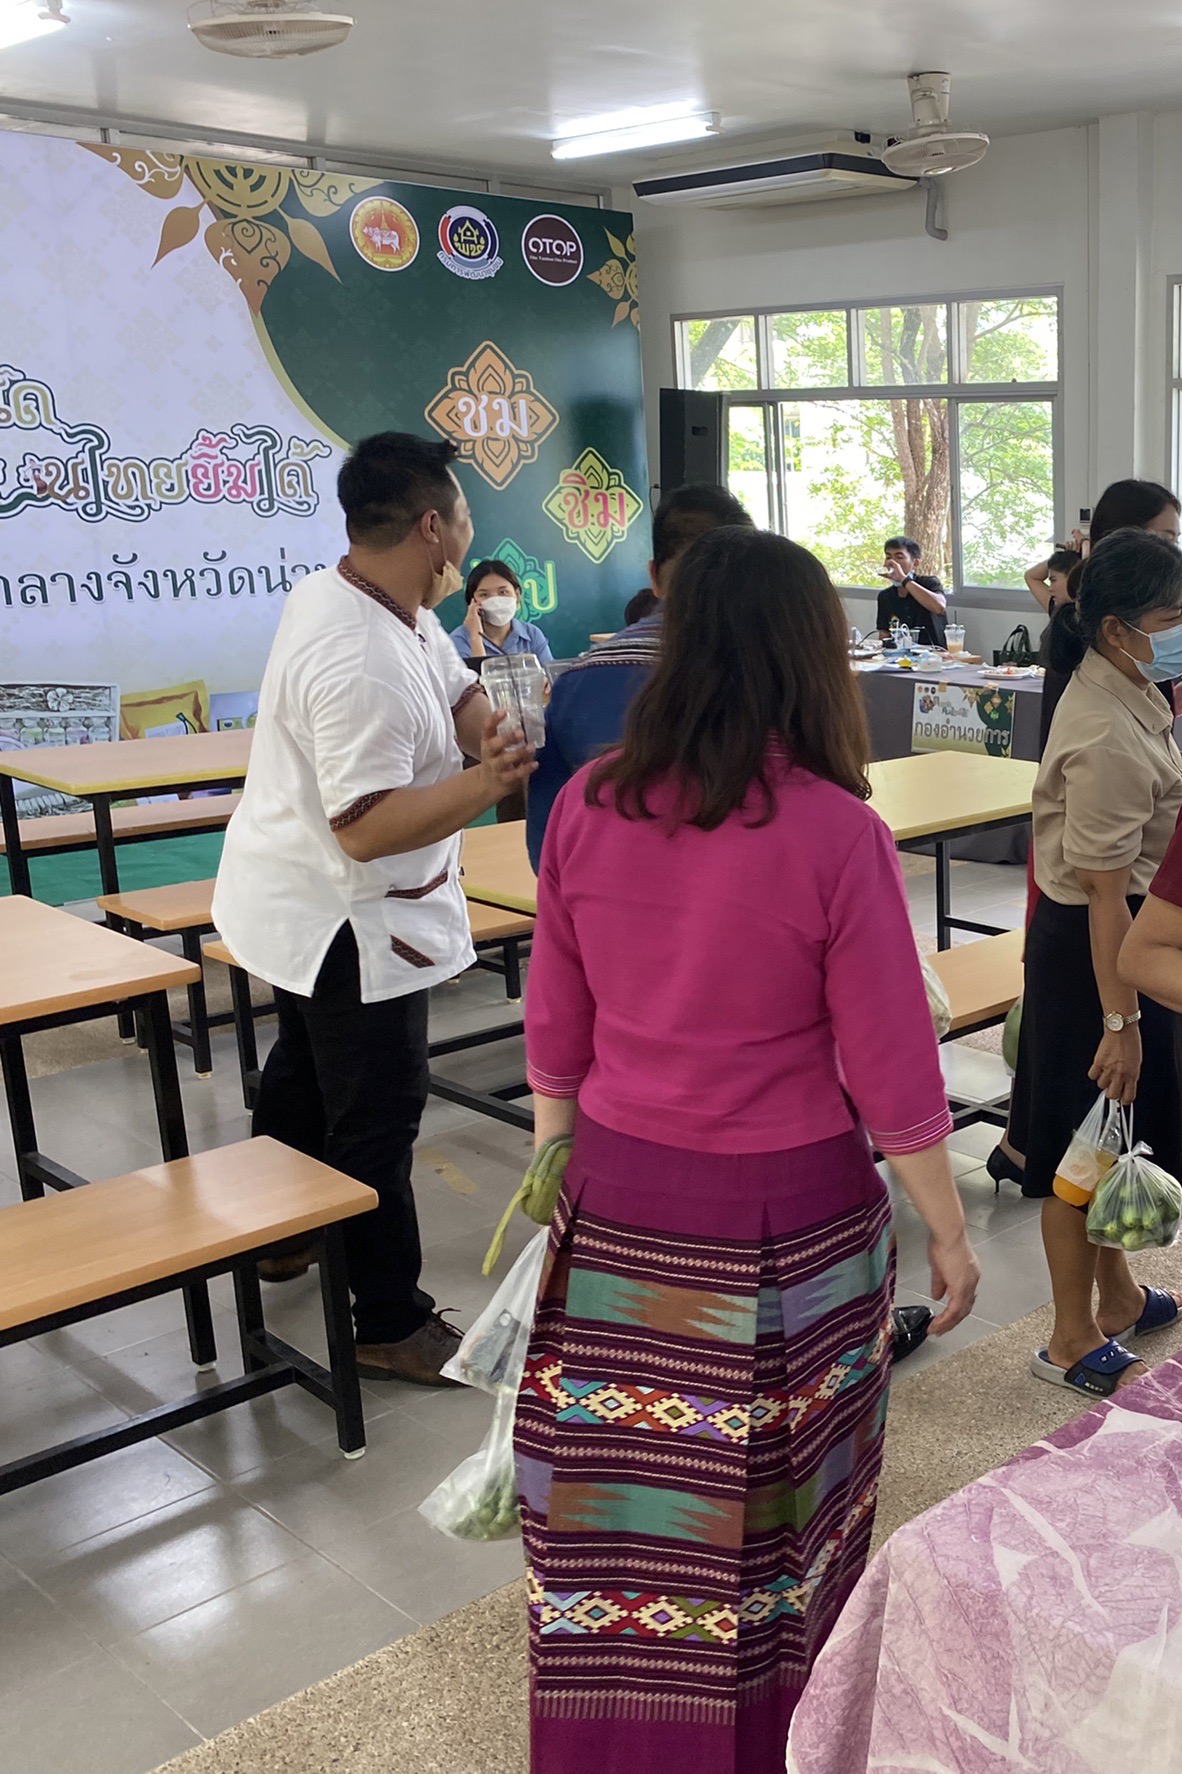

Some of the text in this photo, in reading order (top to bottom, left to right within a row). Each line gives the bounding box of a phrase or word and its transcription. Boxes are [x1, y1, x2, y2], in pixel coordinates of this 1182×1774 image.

[528, 237, 577, 256] OTOP
[458, 394, 529, 438] ชม
[562, 473, 626, 529] ชิม
[914, 718, 1010, 746] กองอำนวยการ
